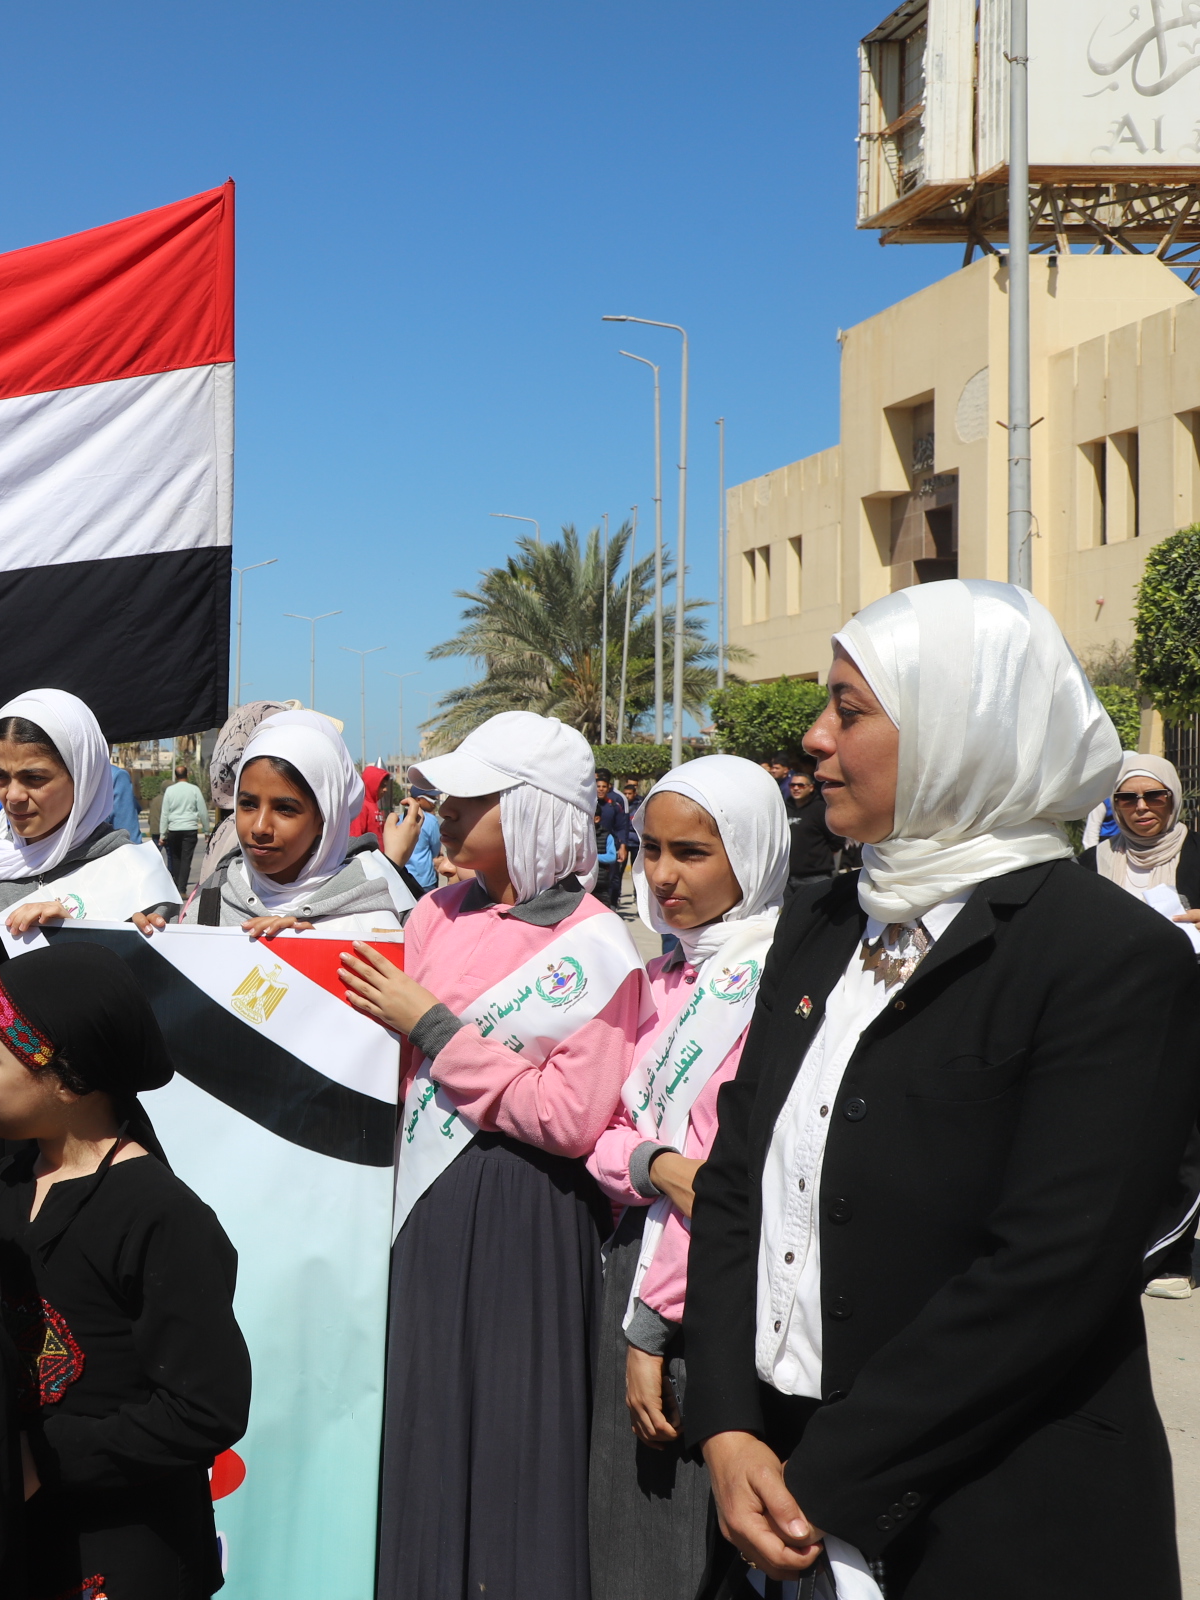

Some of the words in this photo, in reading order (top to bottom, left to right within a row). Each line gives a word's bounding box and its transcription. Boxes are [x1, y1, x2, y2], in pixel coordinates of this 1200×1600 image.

[490, 985, 533, 1019] مدرسة
[475, 1011, 498, 1038] الش
[665, 1039, 704, 1102] للتعليم
[636, 1068, 656, 1111] شريف
[404, 1109, 419, 1144] حسين
